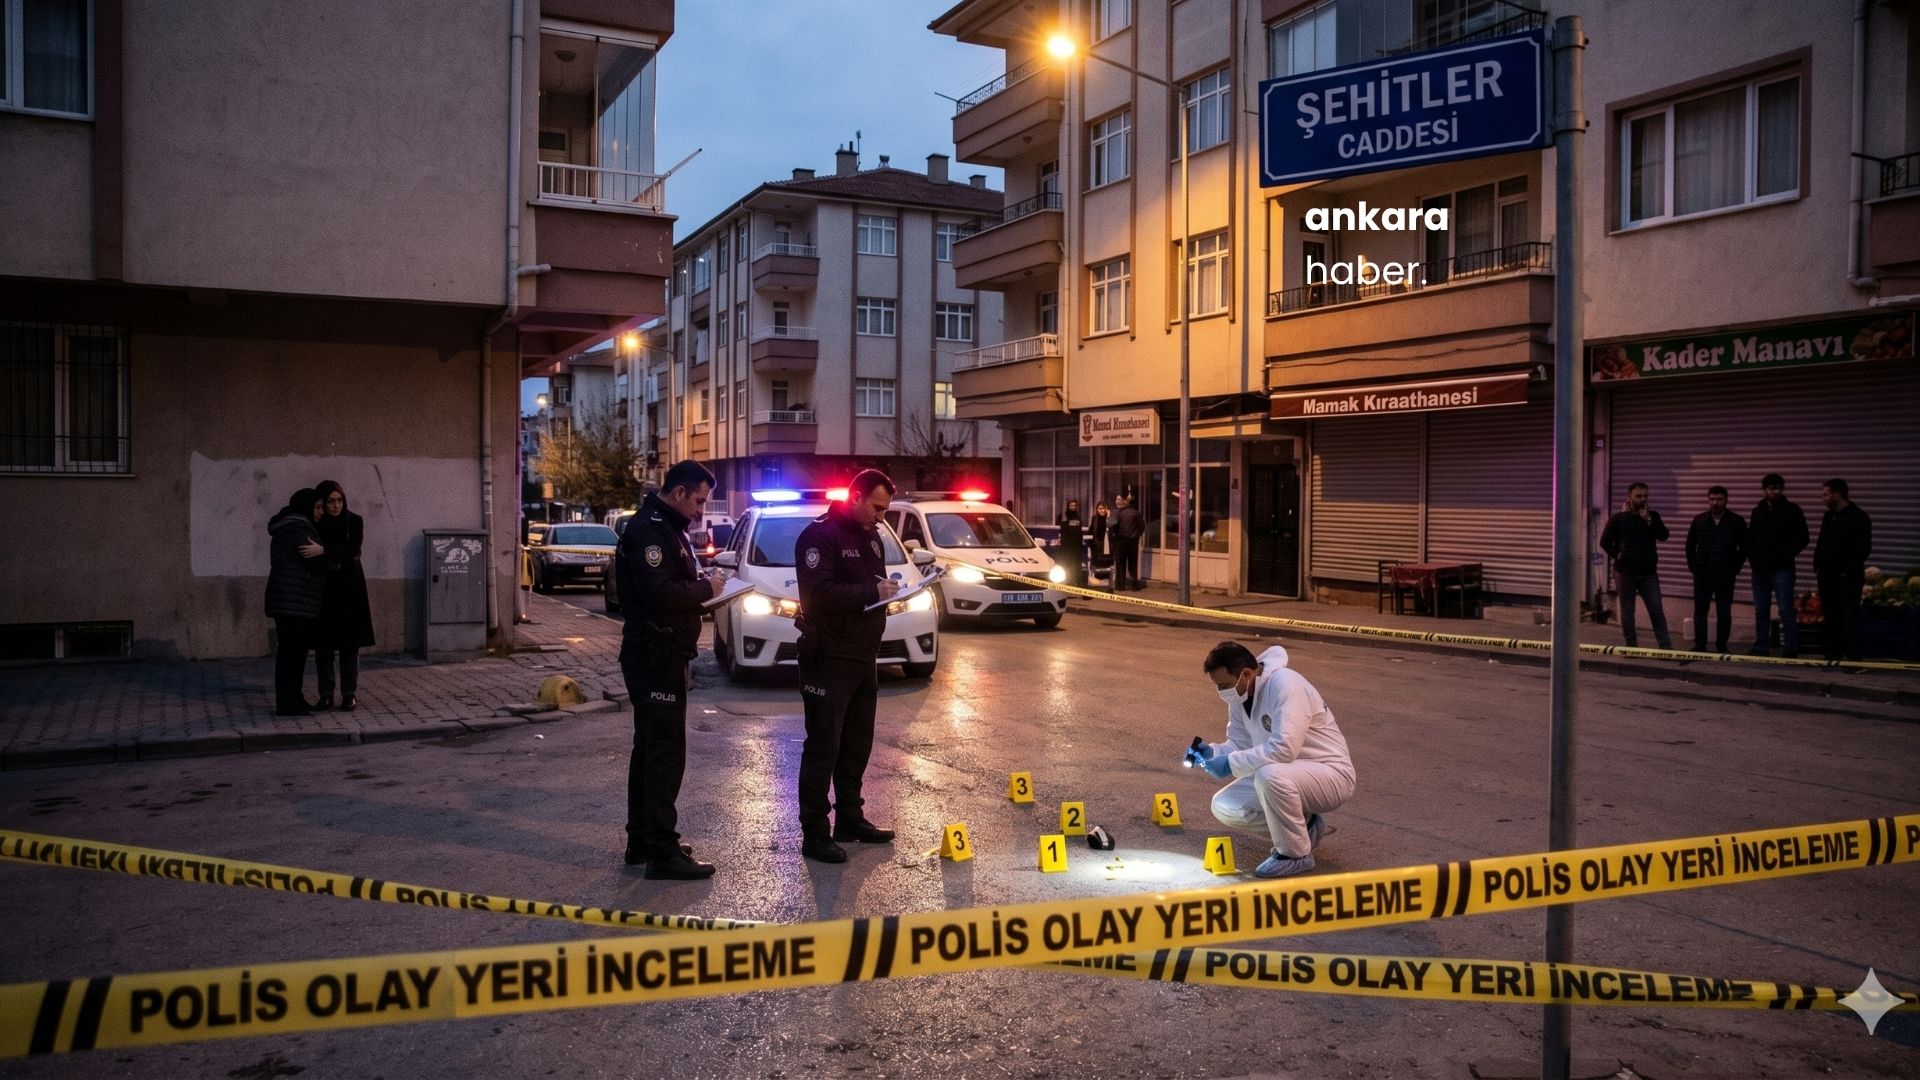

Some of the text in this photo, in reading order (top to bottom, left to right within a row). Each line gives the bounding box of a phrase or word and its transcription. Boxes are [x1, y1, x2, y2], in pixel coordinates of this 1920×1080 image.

[1296, 60, 1504, 139] ŞEHİTLER
[1337, 111, 1459, 159] CADDESİ
[1641, 335, 1844, 372] Kader Manavı
[1303, 386, 1478, 414] Mamak Kıraathanesi
[1016, 777, 1028, 796] 3
[1067, 808, 1081, 828] 2
[1161, 799, 1174, 818] 3
[953, 830, 965, 851] 3
[1047, 841, 1057, 862] 1
[1215, 843, 1226, 865] 1
[1483, 857, 1571, 903] POLİS
[1580, 852, 1654, 892] OLAY
[1660, 837, 1725, 884] YERİ
[1732, 830, 1860, 874] İNCELEME
[911, 877, 1423, 964] POLİS OLAY YERİ İNCELEME
[130, 936, 817, 1034] POLİS OLAY YERİ İNCELEME
[1328, 957, 1432, 993] OLAY
[1443, 961, 1535, 997] YERİ
